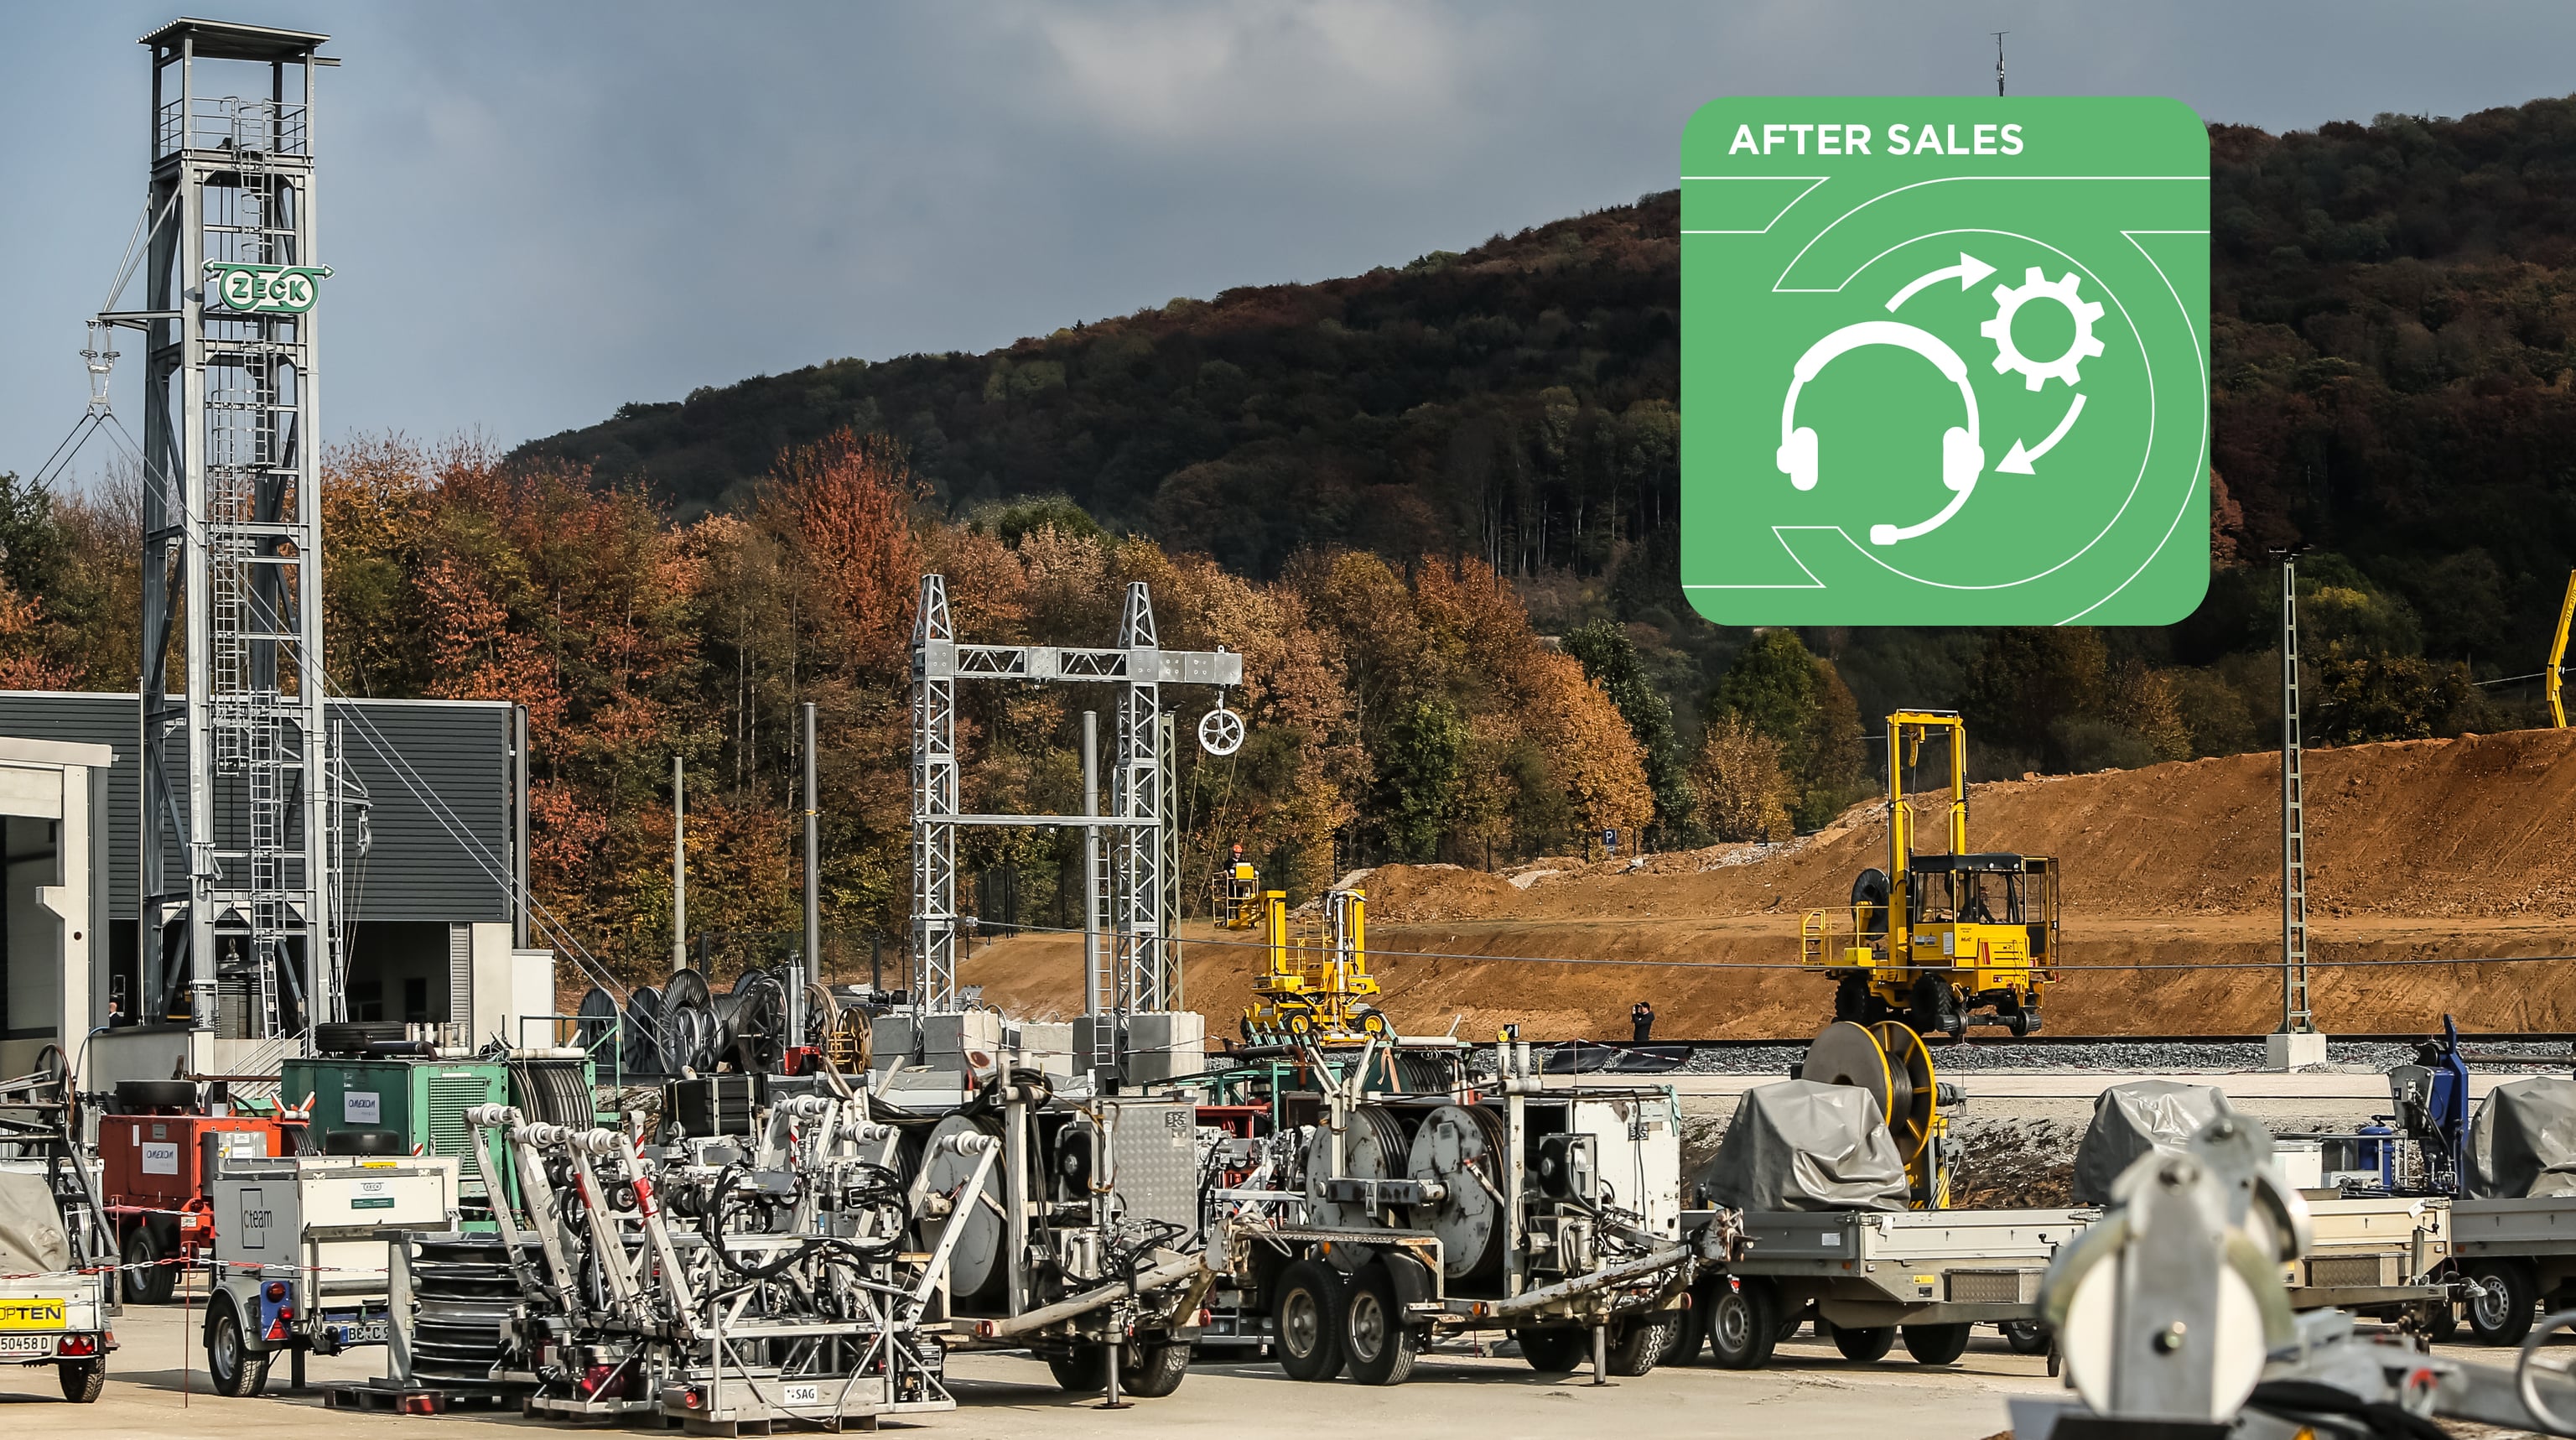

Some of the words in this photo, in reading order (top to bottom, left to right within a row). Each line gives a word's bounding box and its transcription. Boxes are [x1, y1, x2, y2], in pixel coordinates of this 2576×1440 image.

[232, 277, 306, 300] ZECK
[1606, 831, 1613, 844] P
[349, 1328, 364, 1340] BE
[373, 1327, 380, 1339] C
[1, 1338, 38, 1349] 50458
[41, 1338, 48, 1349] D
[796, 1389, 815, 1400] SAG
